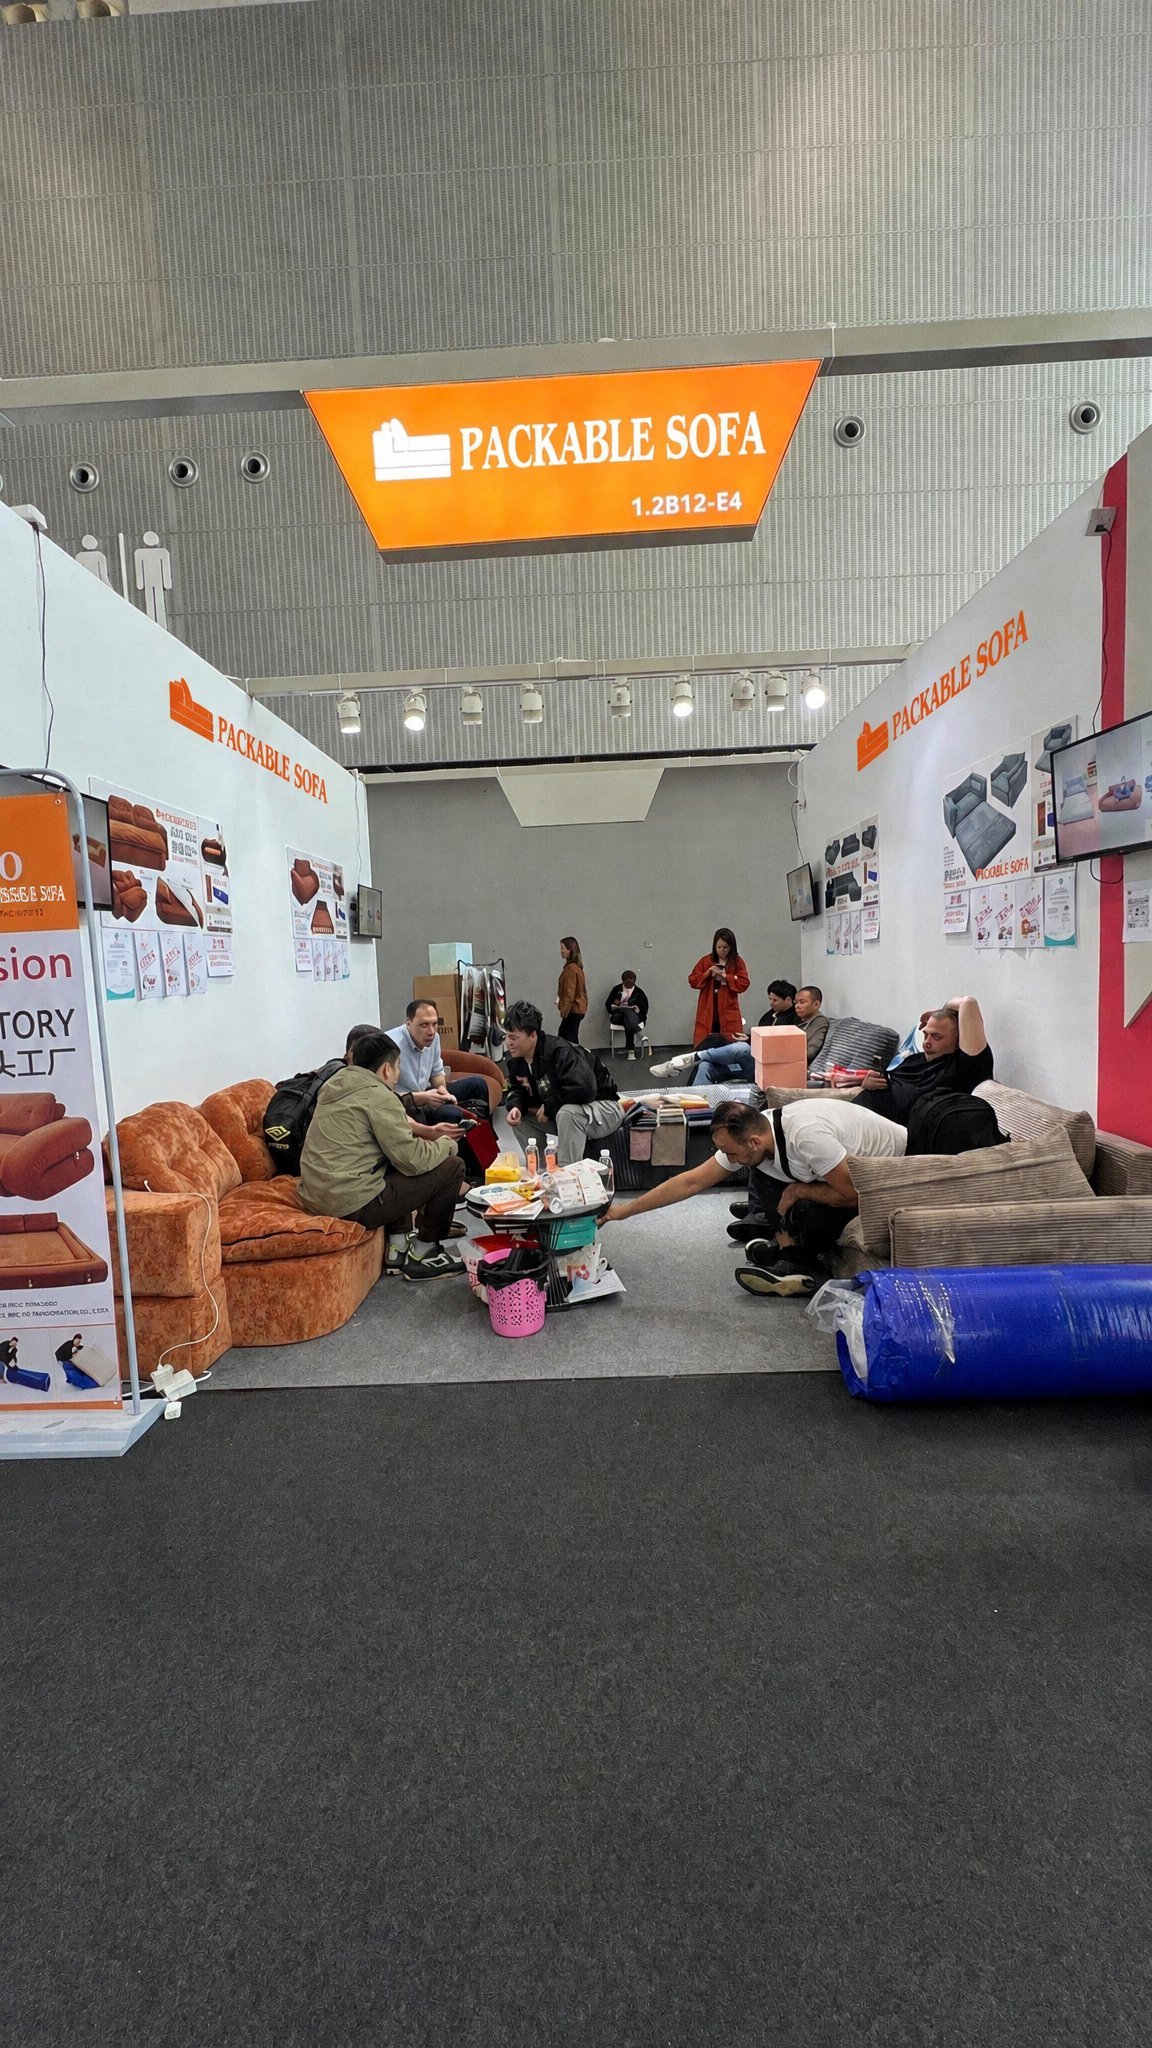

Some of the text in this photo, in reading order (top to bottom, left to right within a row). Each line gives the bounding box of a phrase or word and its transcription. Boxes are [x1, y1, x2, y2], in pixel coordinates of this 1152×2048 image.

[460, 411, 766, 470] PACKABLE SOFA
[632, 491, 742, 517] 1.2B12-E4
[892, 610, 1029, 741] PACKABLE SOFA
[218, 716, 328, 804] PACKABLE SOFA
